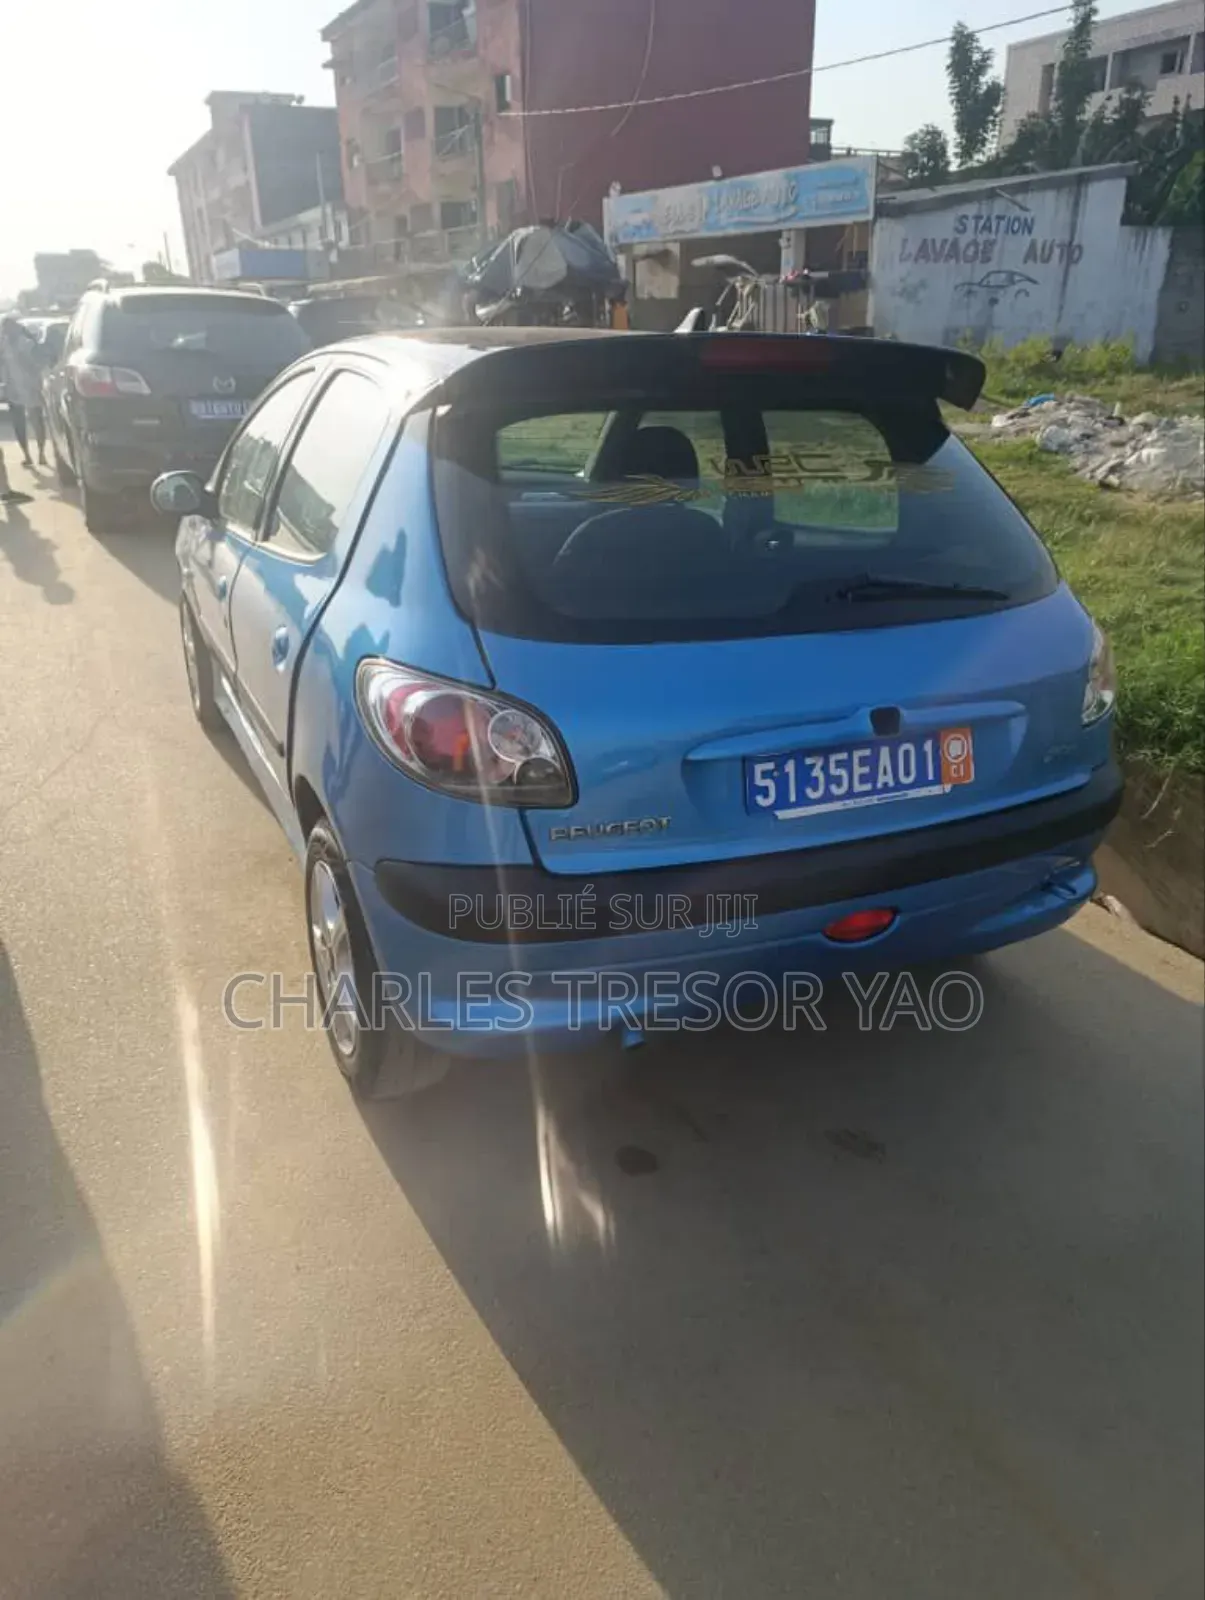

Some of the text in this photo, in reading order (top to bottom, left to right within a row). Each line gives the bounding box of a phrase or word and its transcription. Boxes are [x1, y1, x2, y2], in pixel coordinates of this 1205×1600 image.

[954, 214, 1035, 236] STATION
[899, 237, 1084, 265] LAVAGE AUTO
[753, 739, 935, 808] 5135EA01
[549, 815, 671, 841] PEUGEOT
